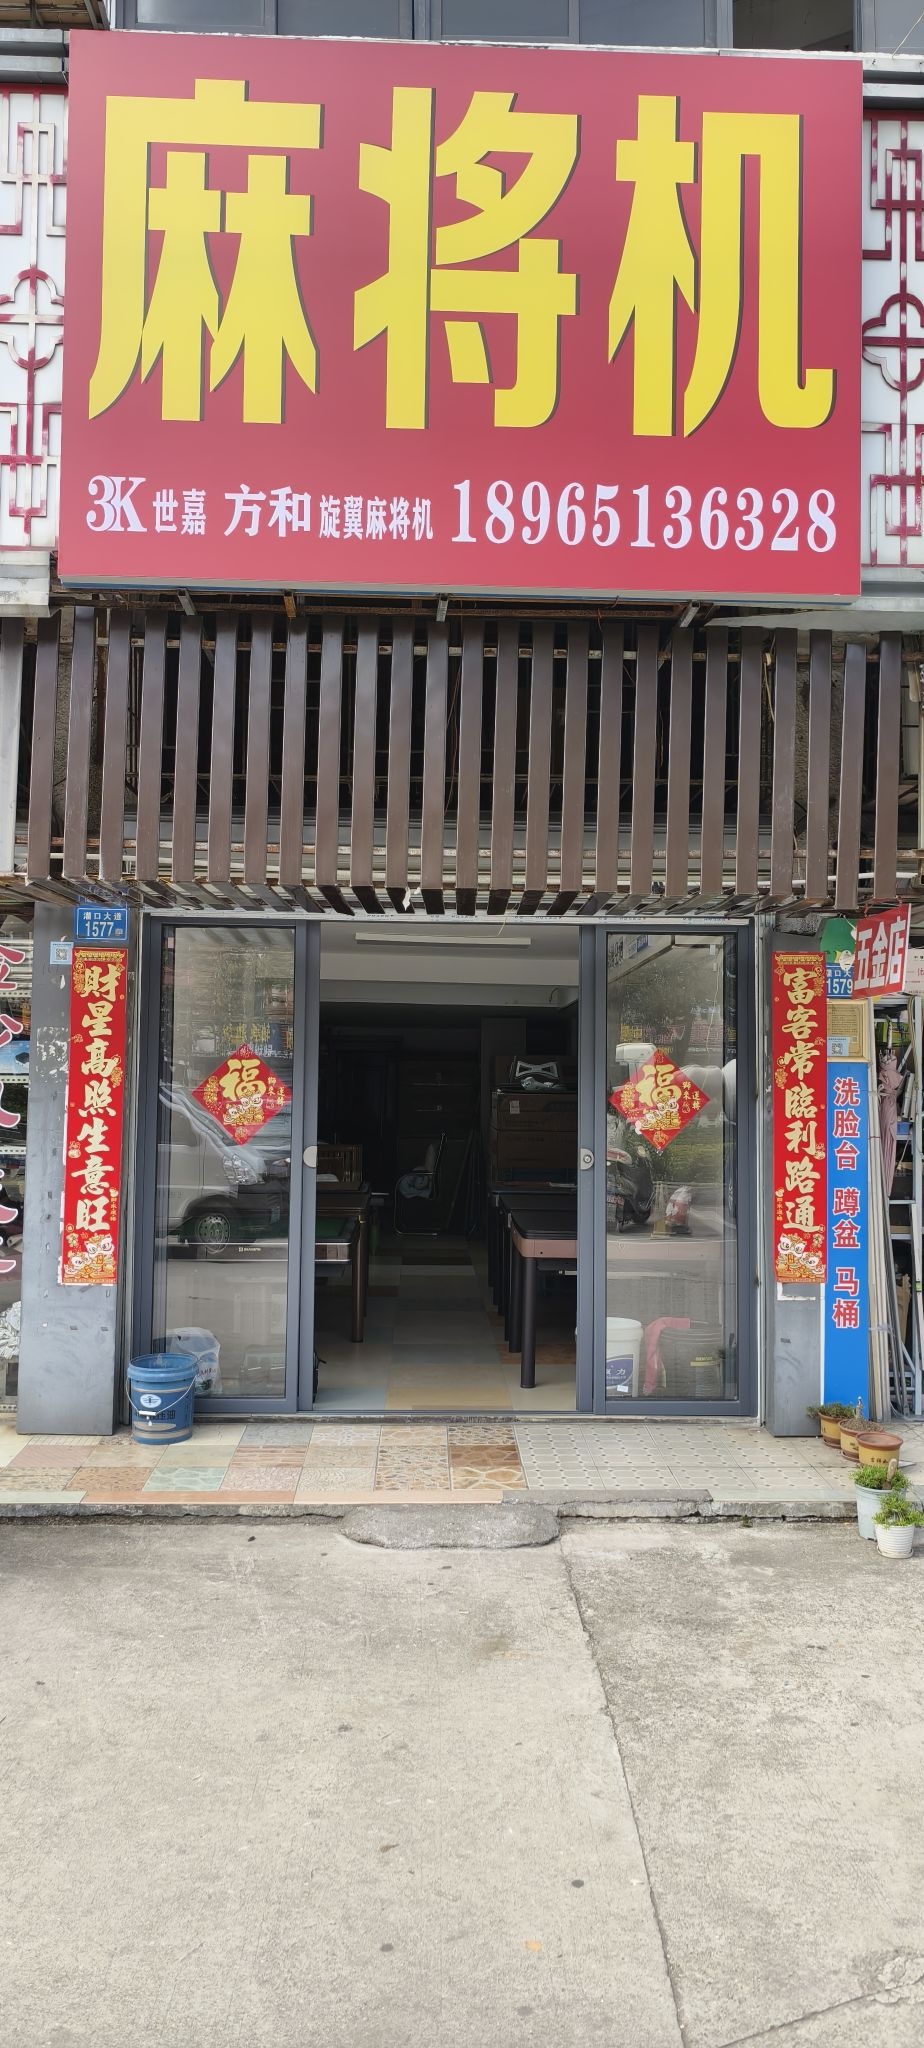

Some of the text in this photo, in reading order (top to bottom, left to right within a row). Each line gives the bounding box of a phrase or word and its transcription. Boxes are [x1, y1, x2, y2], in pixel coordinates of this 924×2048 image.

[88, 78, 838, 438] 麻将机
[86, 475, 838, 553] 3K 世嘉 方和 旋翼麻将机 18965136328
[85, 921, 114, 937] 1577
[854, 916, 907, 990] 五金店
[826, 978, 853, 994] 1579
[71, 964, 120, 1232] 財星高照生意旺
[218, 1058, 267, 1101] 福
[635, 1064, 682, 1107] 福
[832, 1077, 861, 1329] 洗脸台 蹲盆 马桶
